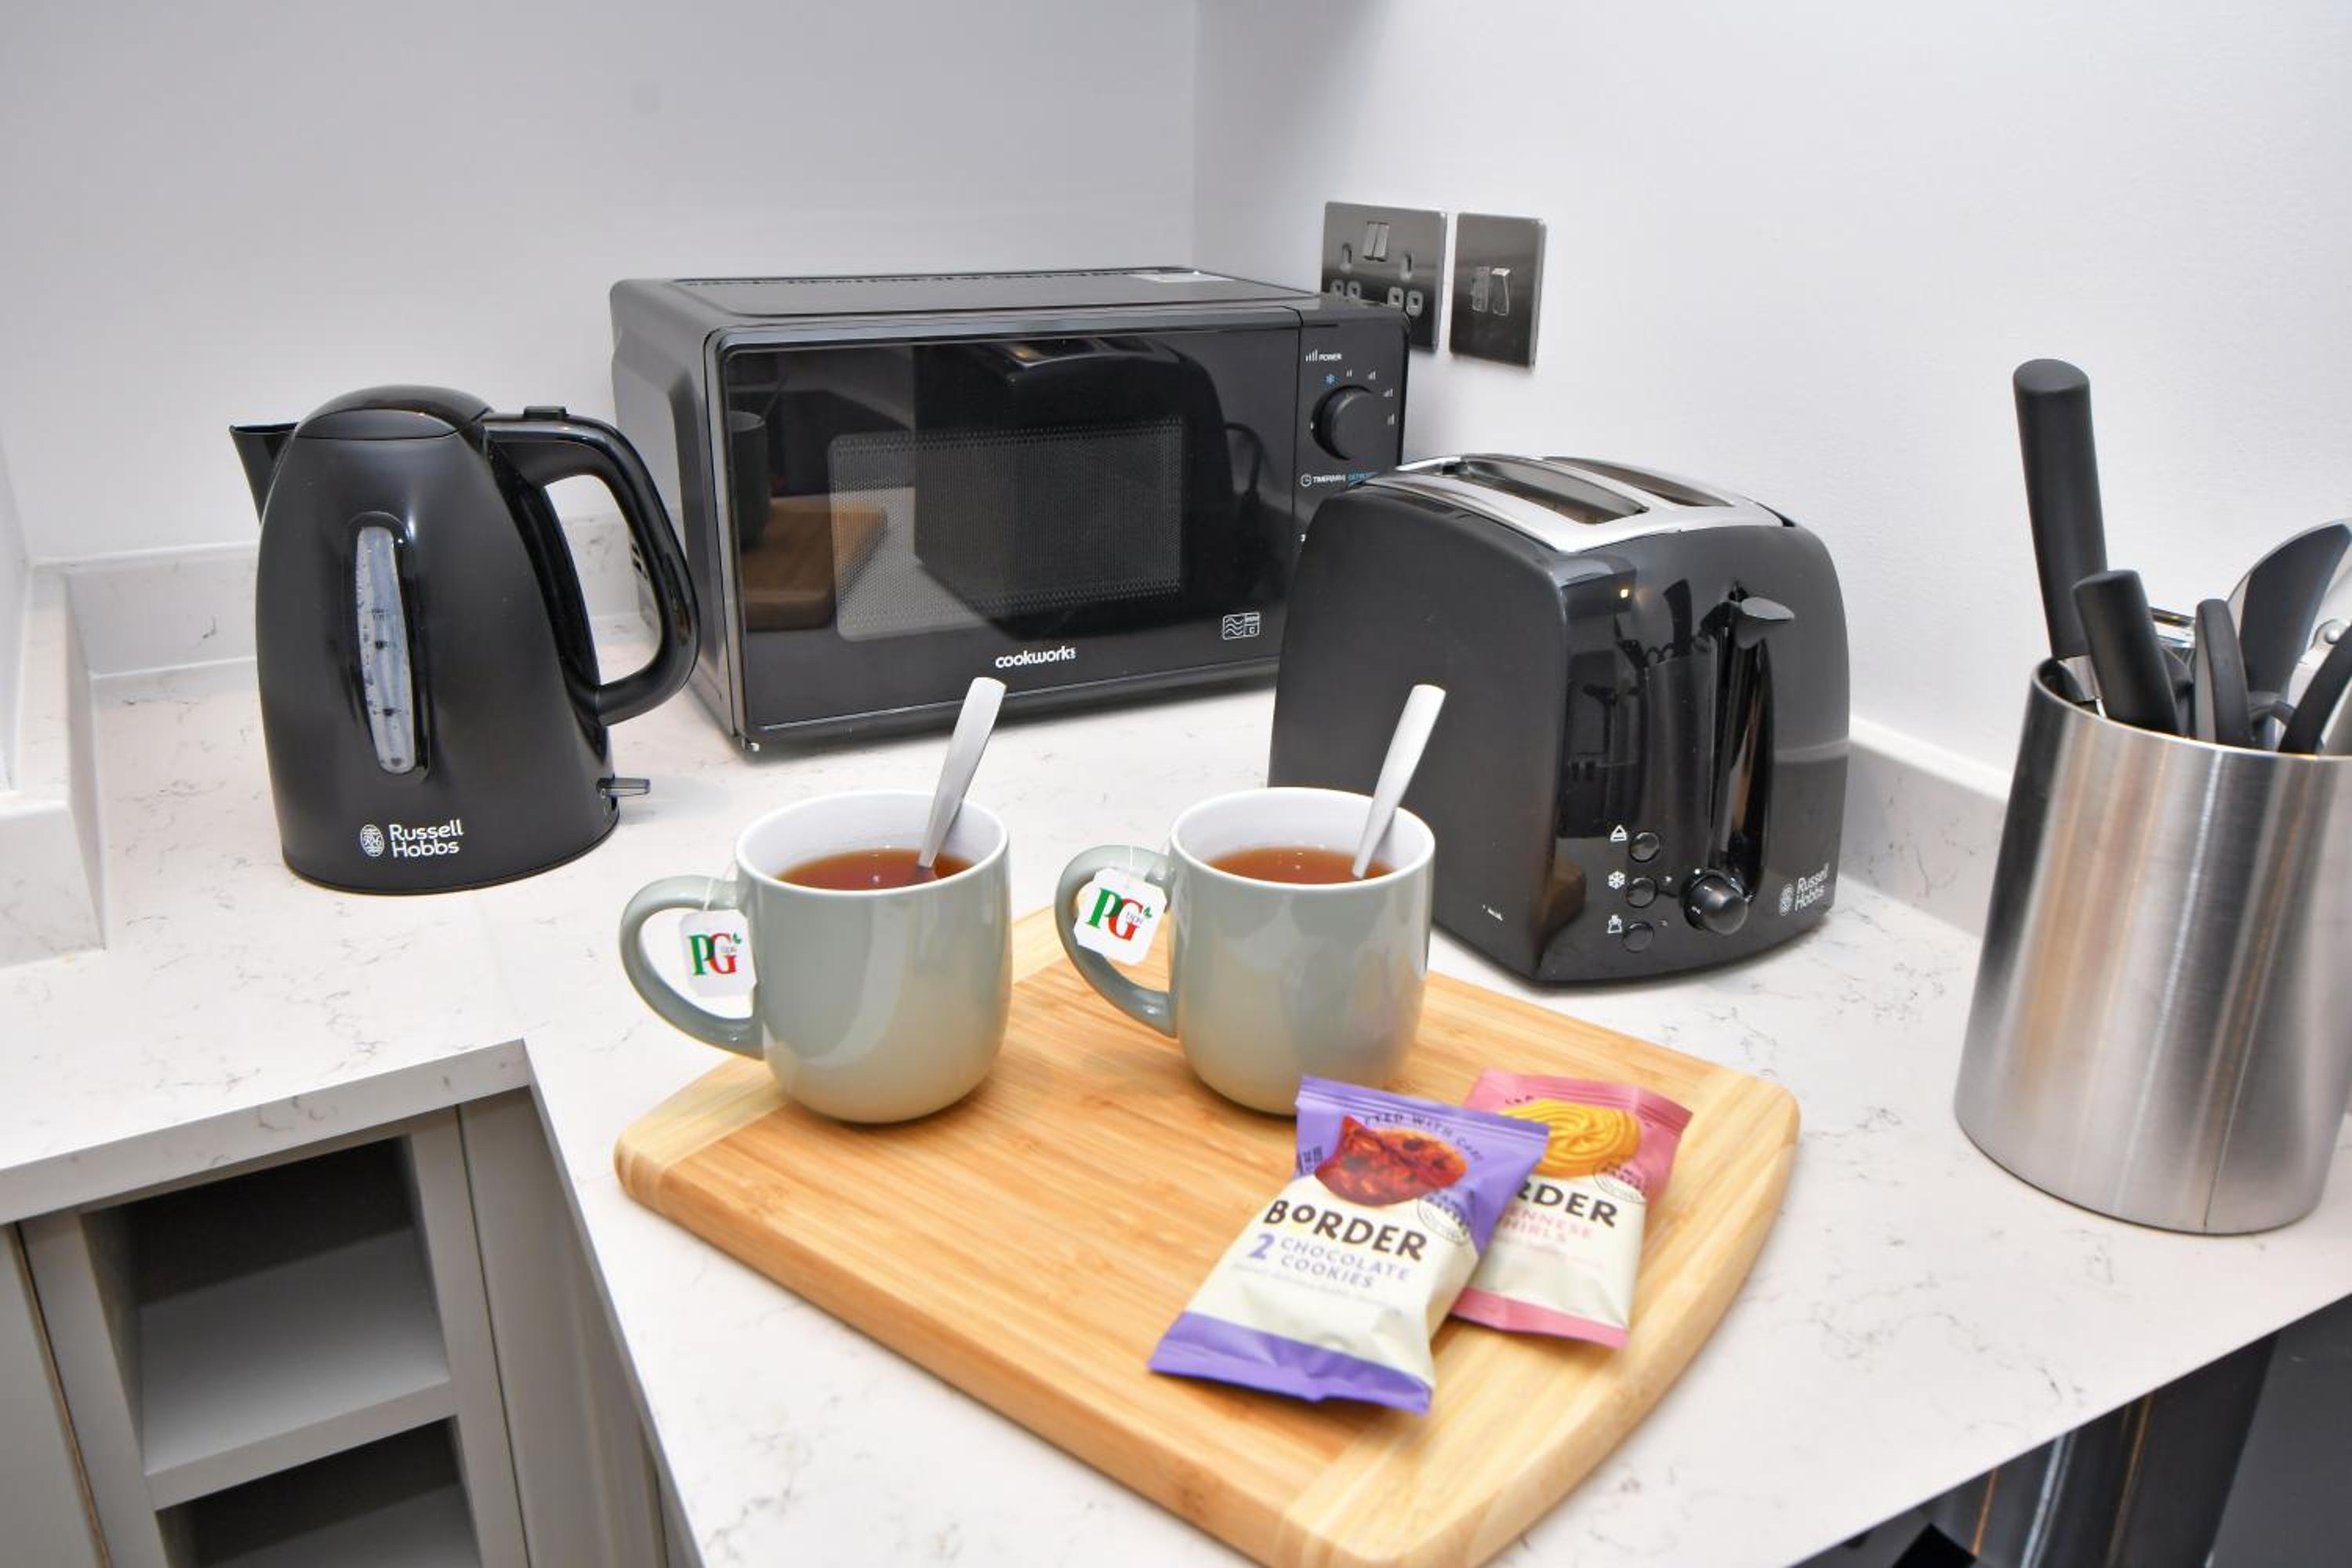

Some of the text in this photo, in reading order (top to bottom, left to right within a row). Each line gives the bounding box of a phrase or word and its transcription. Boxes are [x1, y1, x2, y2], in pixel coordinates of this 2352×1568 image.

[995, 645, 1076, 669] cookworks
[389, 818, 464, 841] Russell
[391, 838, 459, 858] Hobbs
[1085, 887, 1143, 941] PG
[687, 933, 737, 975] PG
[1516, 1180, 1618, 1229] RDER
[1264, 1199, 1427, 1261] BORDER
[1248, 1233, 1410, 1280] 2 CHOCOLATE
[1280, 1254, 1374, 1288] COOKIES
